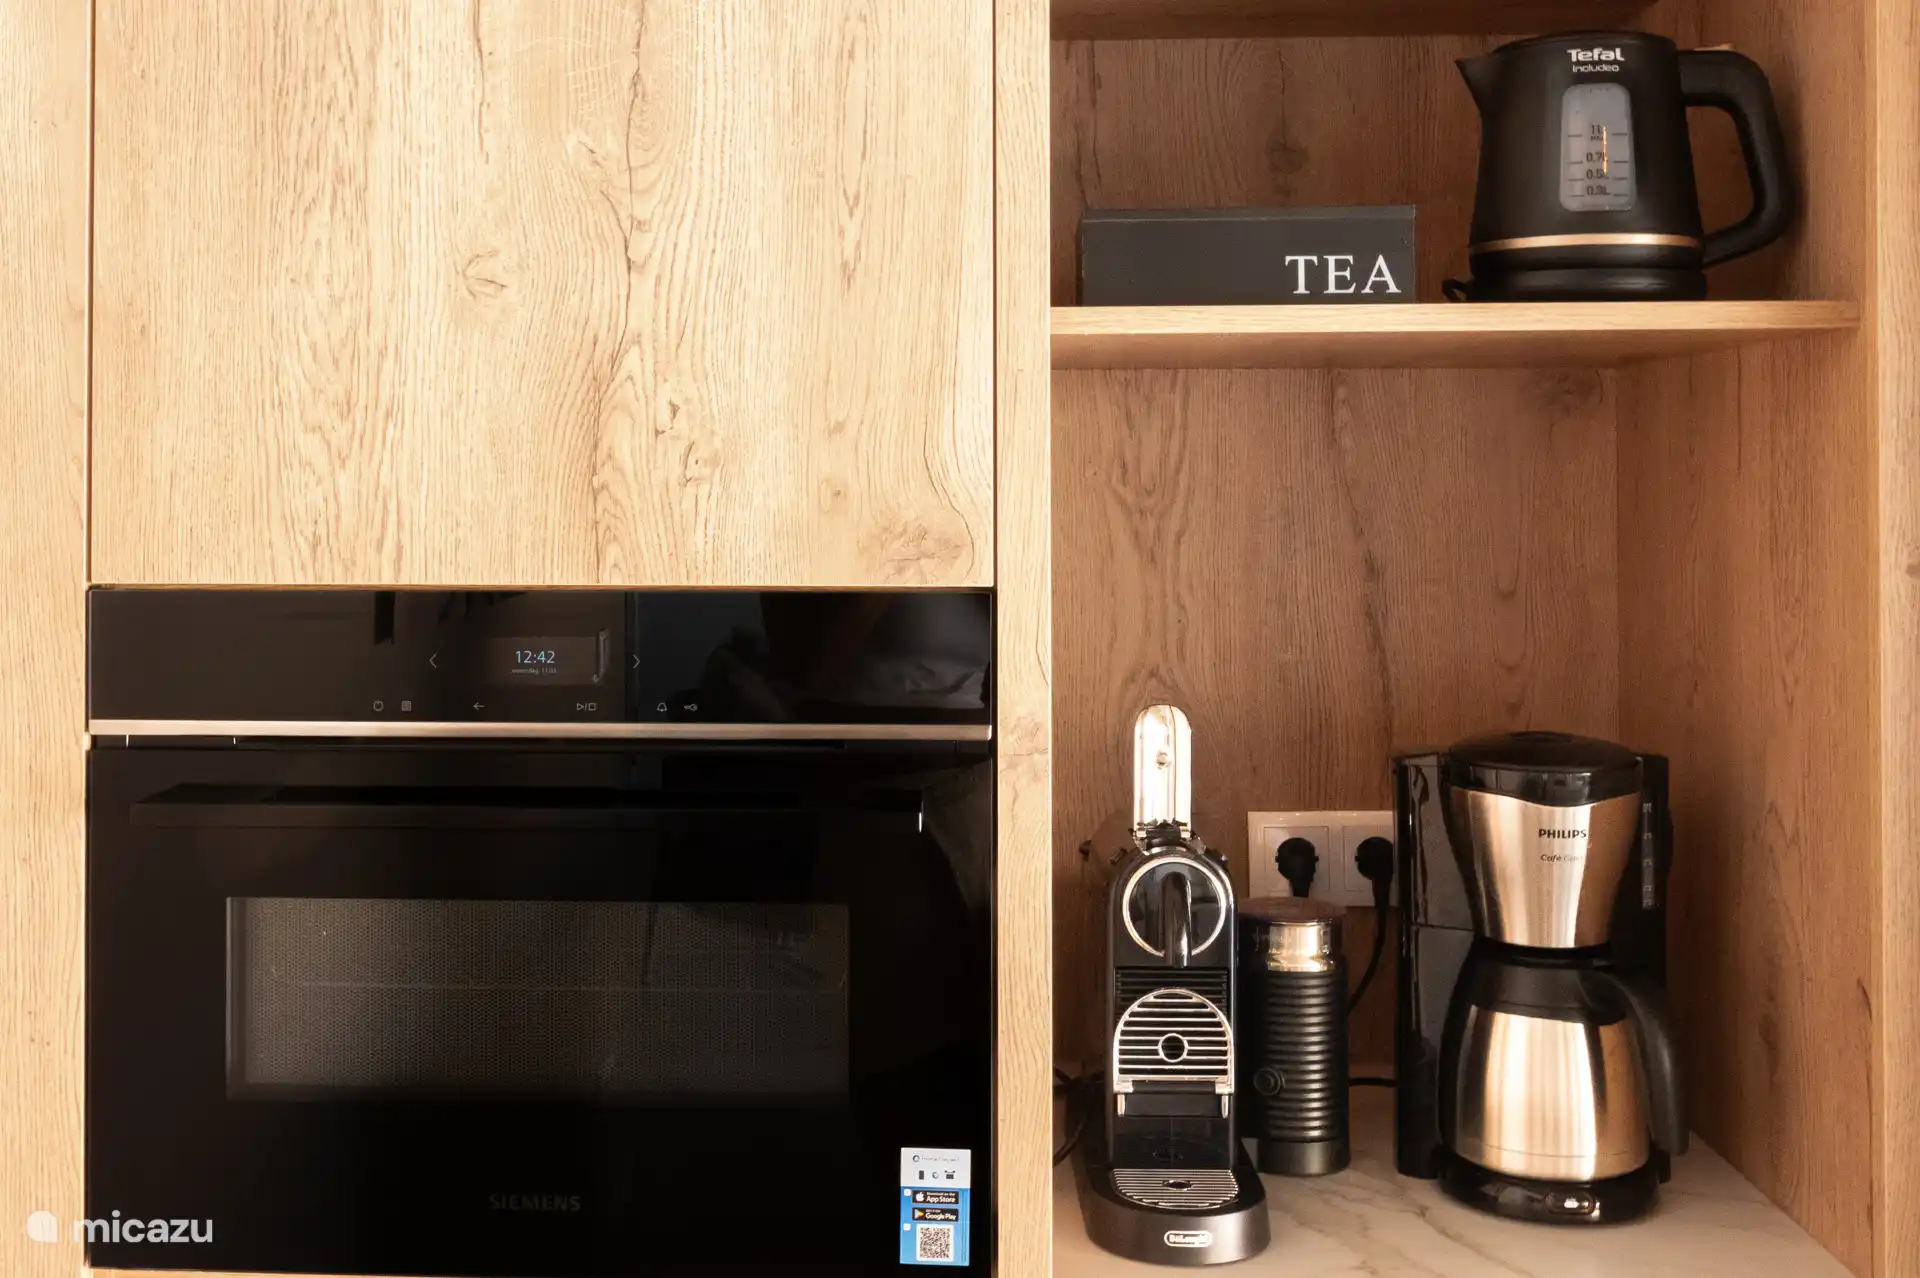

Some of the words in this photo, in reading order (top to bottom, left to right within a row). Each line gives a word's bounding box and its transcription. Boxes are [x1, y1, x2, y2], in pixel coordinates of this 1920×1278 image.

[1567, 47, 1625, 62] Tefal
[1572, 64, 1620, 73] Includeo
[1284, 254, 1402, 294] TEA
[515, 650, 555, 664] 12:42
[1538, 828, 1587, 839] PHILIPS
[489, 1193, 581, 1211] SIEMENS
[926, 1195, 939, 1203] App
[939, 1195, 956, 1203] Store
[925, 1212, 945, 1220] Google
[945, 1213, 957, 1221] Play
